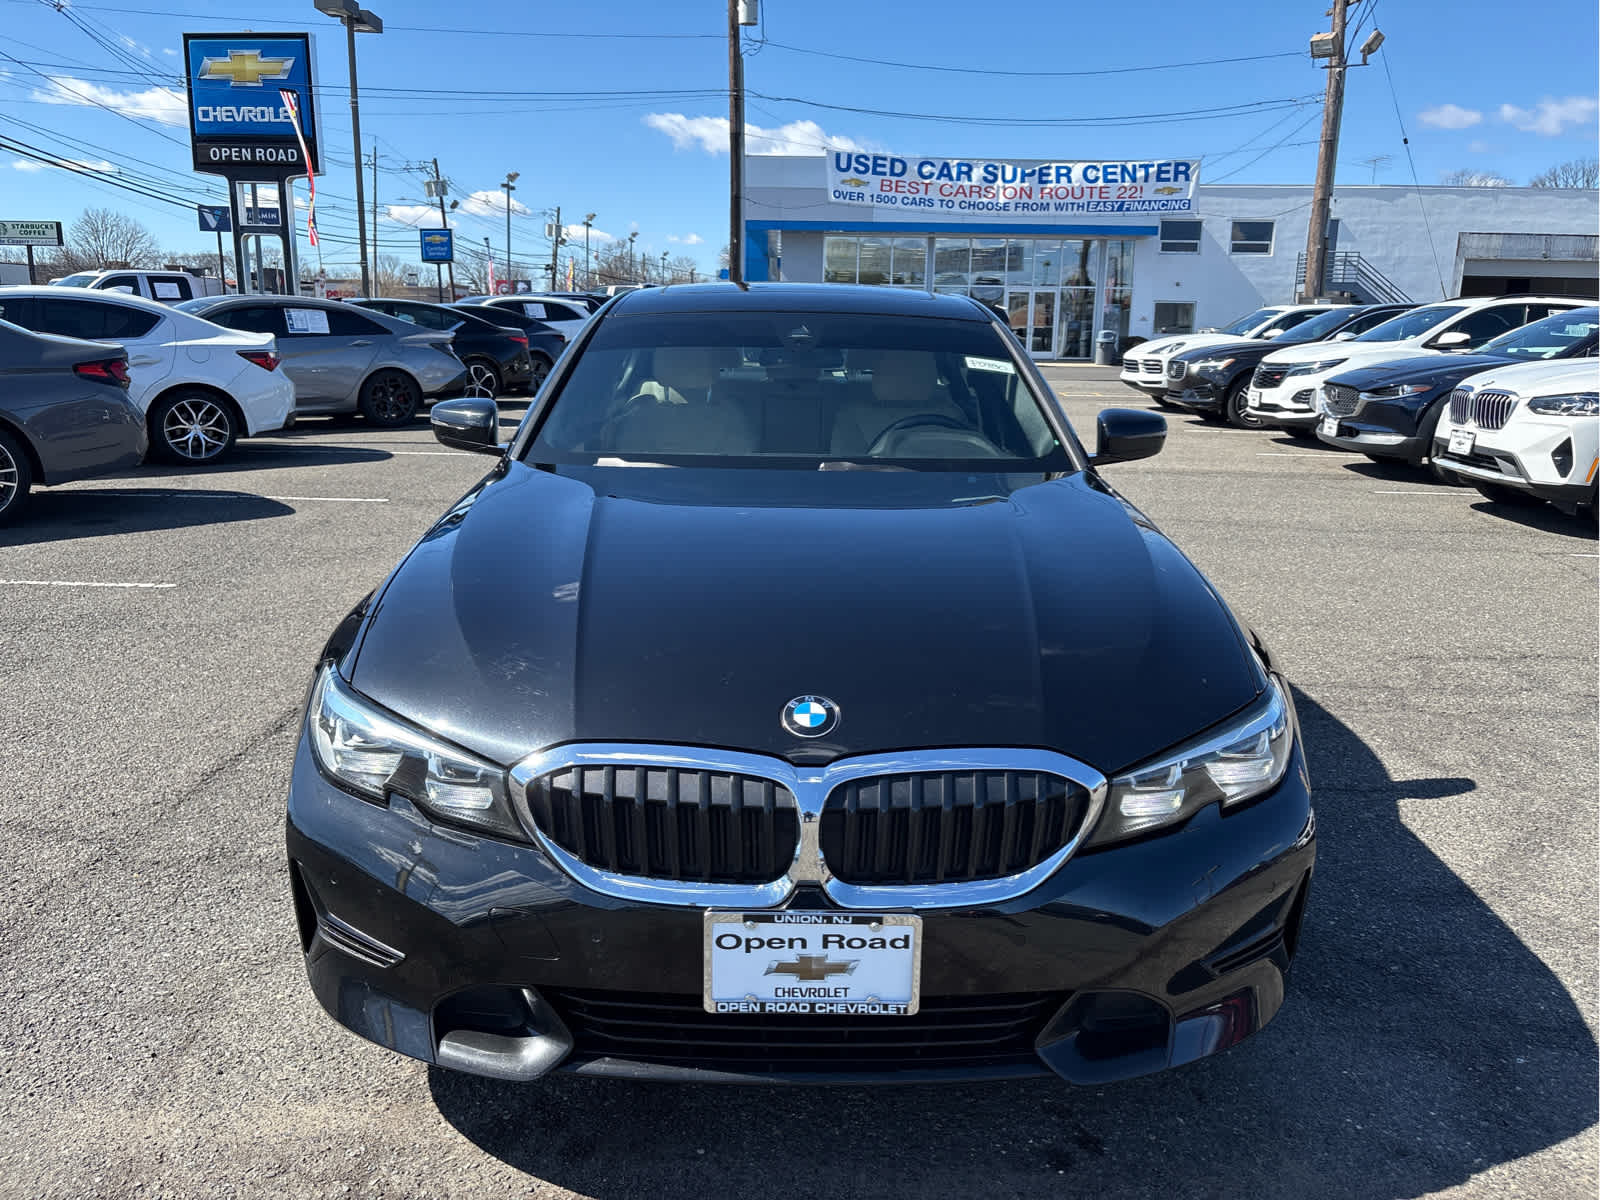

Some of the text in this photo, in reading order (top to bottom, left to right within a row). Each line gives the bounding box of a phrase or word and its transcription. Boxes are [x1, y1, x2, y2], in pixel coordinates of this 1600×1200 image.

[197, 106, 293, 122] CHEVROLE
[209, 147, 298, 162] OPEN ROAD
[834, 152, 1191, 185] USED CAR SUPER CENTER
[880, 178, 1144, 200] BEST CARS ON ROUTE 22!
[832, 189, 1190, 212] OVER 1500 CARS TO CHOOSE FROM WITH EASY FINANCING
[832, 916, 853, 924] NJ
[715, 933, 910, 954] Open Road
[774, 987, 851, 998] CHEVROLET
[717, 1001, 908, 1014] OPEN ROAD CHEVROLET
